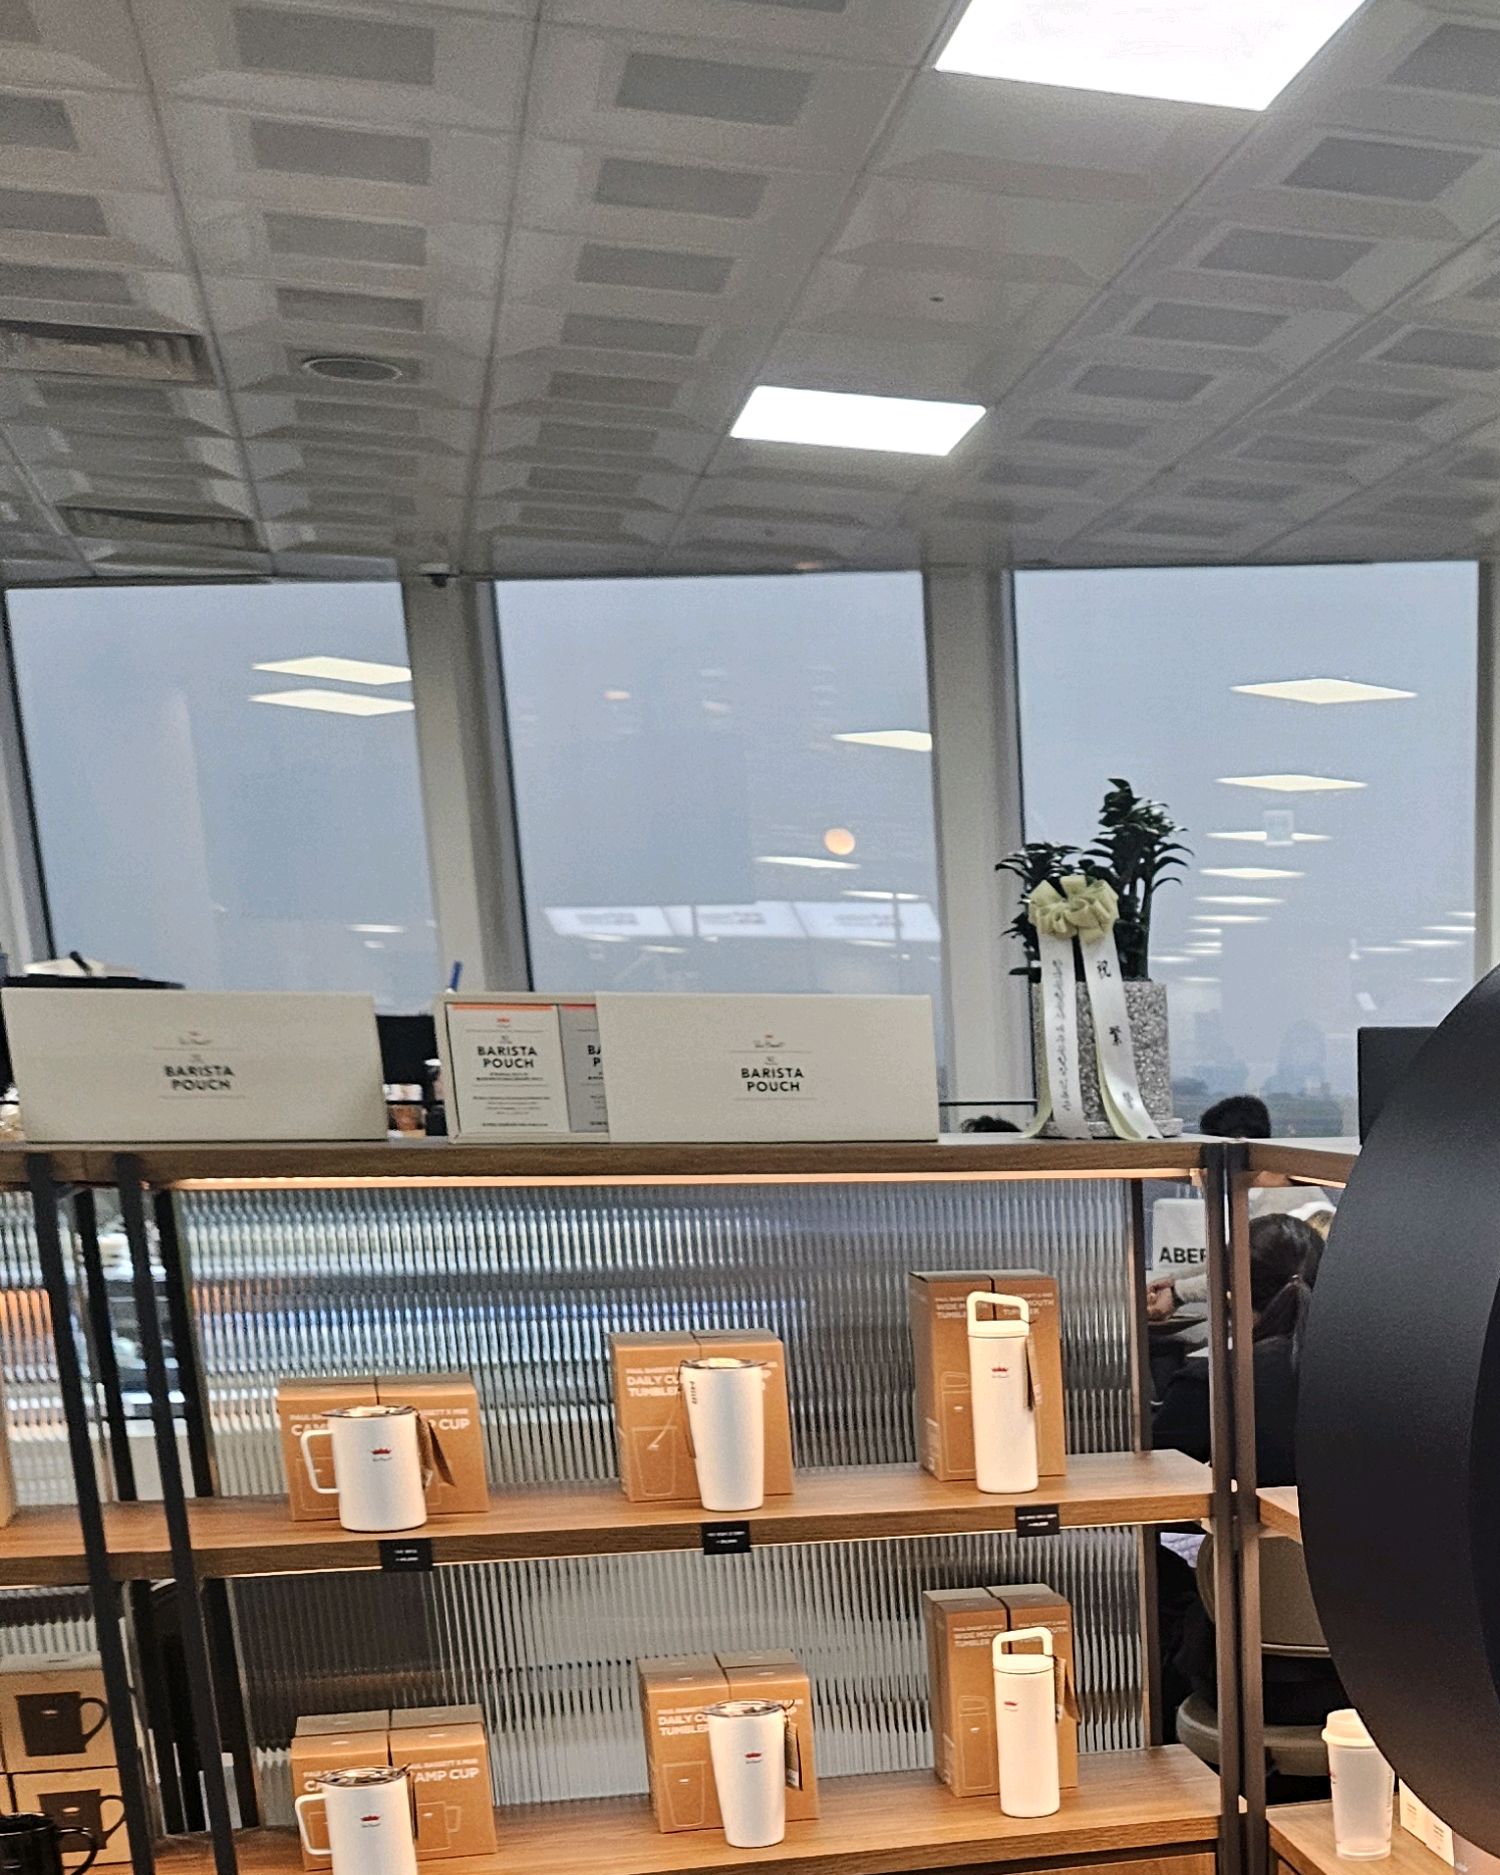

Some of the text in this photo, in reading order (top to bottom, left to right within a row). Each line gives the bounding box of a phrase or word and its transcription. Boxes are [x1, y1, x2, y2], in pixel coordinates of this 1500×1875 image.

[477, 1046, 538, 1056] BARISTA
[483, 1058, 535, 1068] POUCH
[164, 1065, 235, 1077] BARISTA
[741, 1067, 804, 1078] BARISTA
[172, 1079, 231, 1091] POUCH
[746, 1081, 801, 1092] POUCH
[626, 1374, 665, 1387] DAILY
[439, 1418, 470, 1430] CUP
[658, 1714, 692, 1726] DAILY
[415, 1767, 479, 1783] AMP CUP
